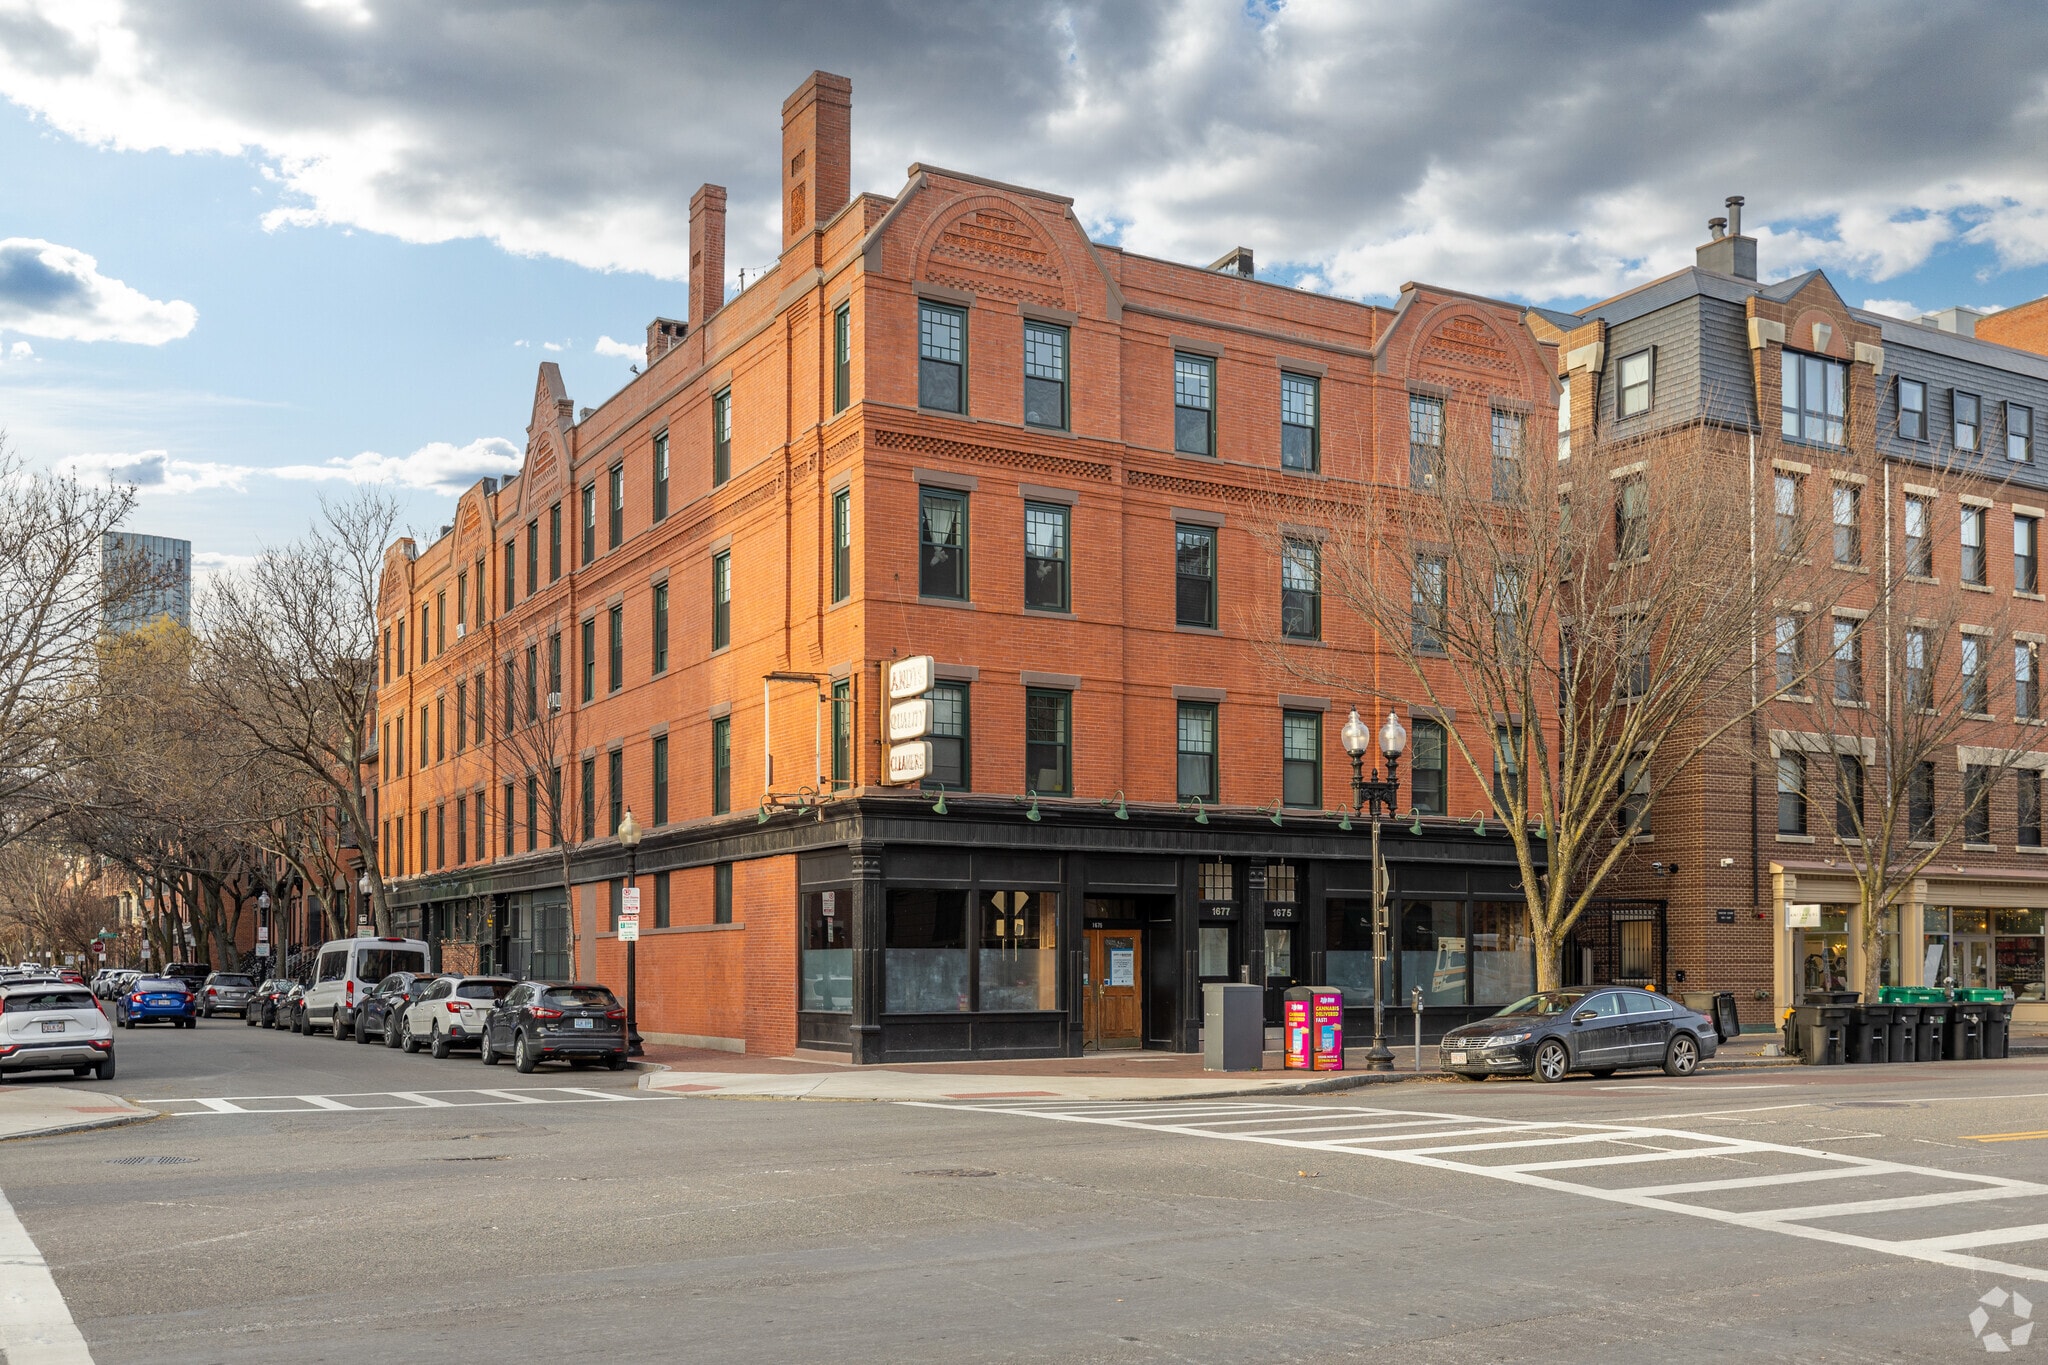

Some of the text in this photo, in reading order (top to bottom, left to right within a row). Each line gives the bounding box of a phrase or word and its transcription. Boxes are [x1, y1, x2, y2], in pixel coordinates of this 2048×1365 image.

[890, 709, 924, 730] QUALITY
[890, 752, 924, 772] CLEANERS
[1212, 907, 1231, 916] 1677
[1272, 908, 1292, 917] 1675
